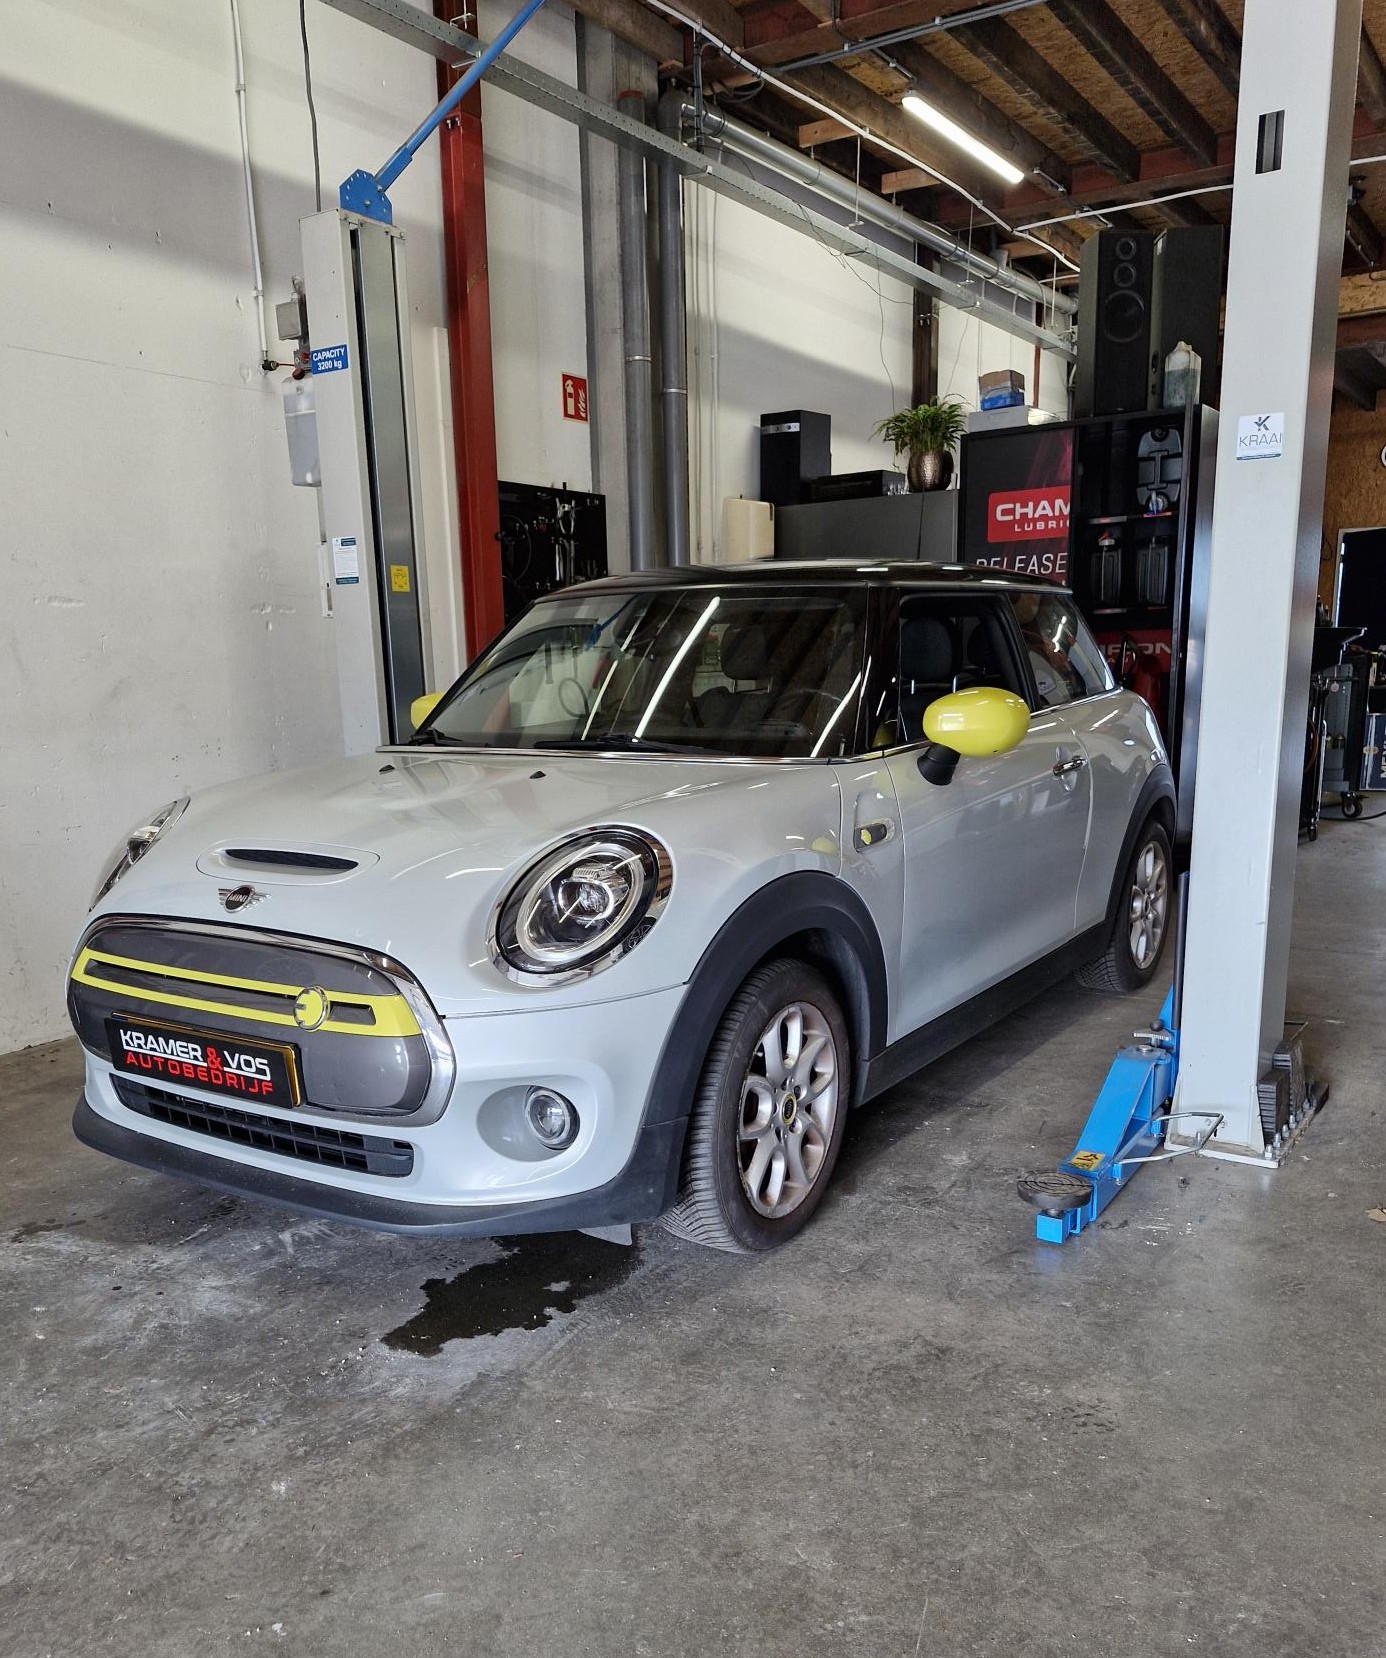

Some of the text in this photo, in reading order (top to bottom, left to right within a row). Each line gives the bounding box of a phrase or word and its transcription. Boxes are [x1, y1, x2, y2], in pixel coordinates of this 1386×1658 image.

[312, 347, 345, 361] CAPACITY
[317, 359, 342, 371] 3200 kg
[1239, 432, 1282, 447] KRAAI
[119, 1029, 271, 1077] KRAMER & VOS
[125, 1051, 274, 1095] AUTOBEDRIJF
